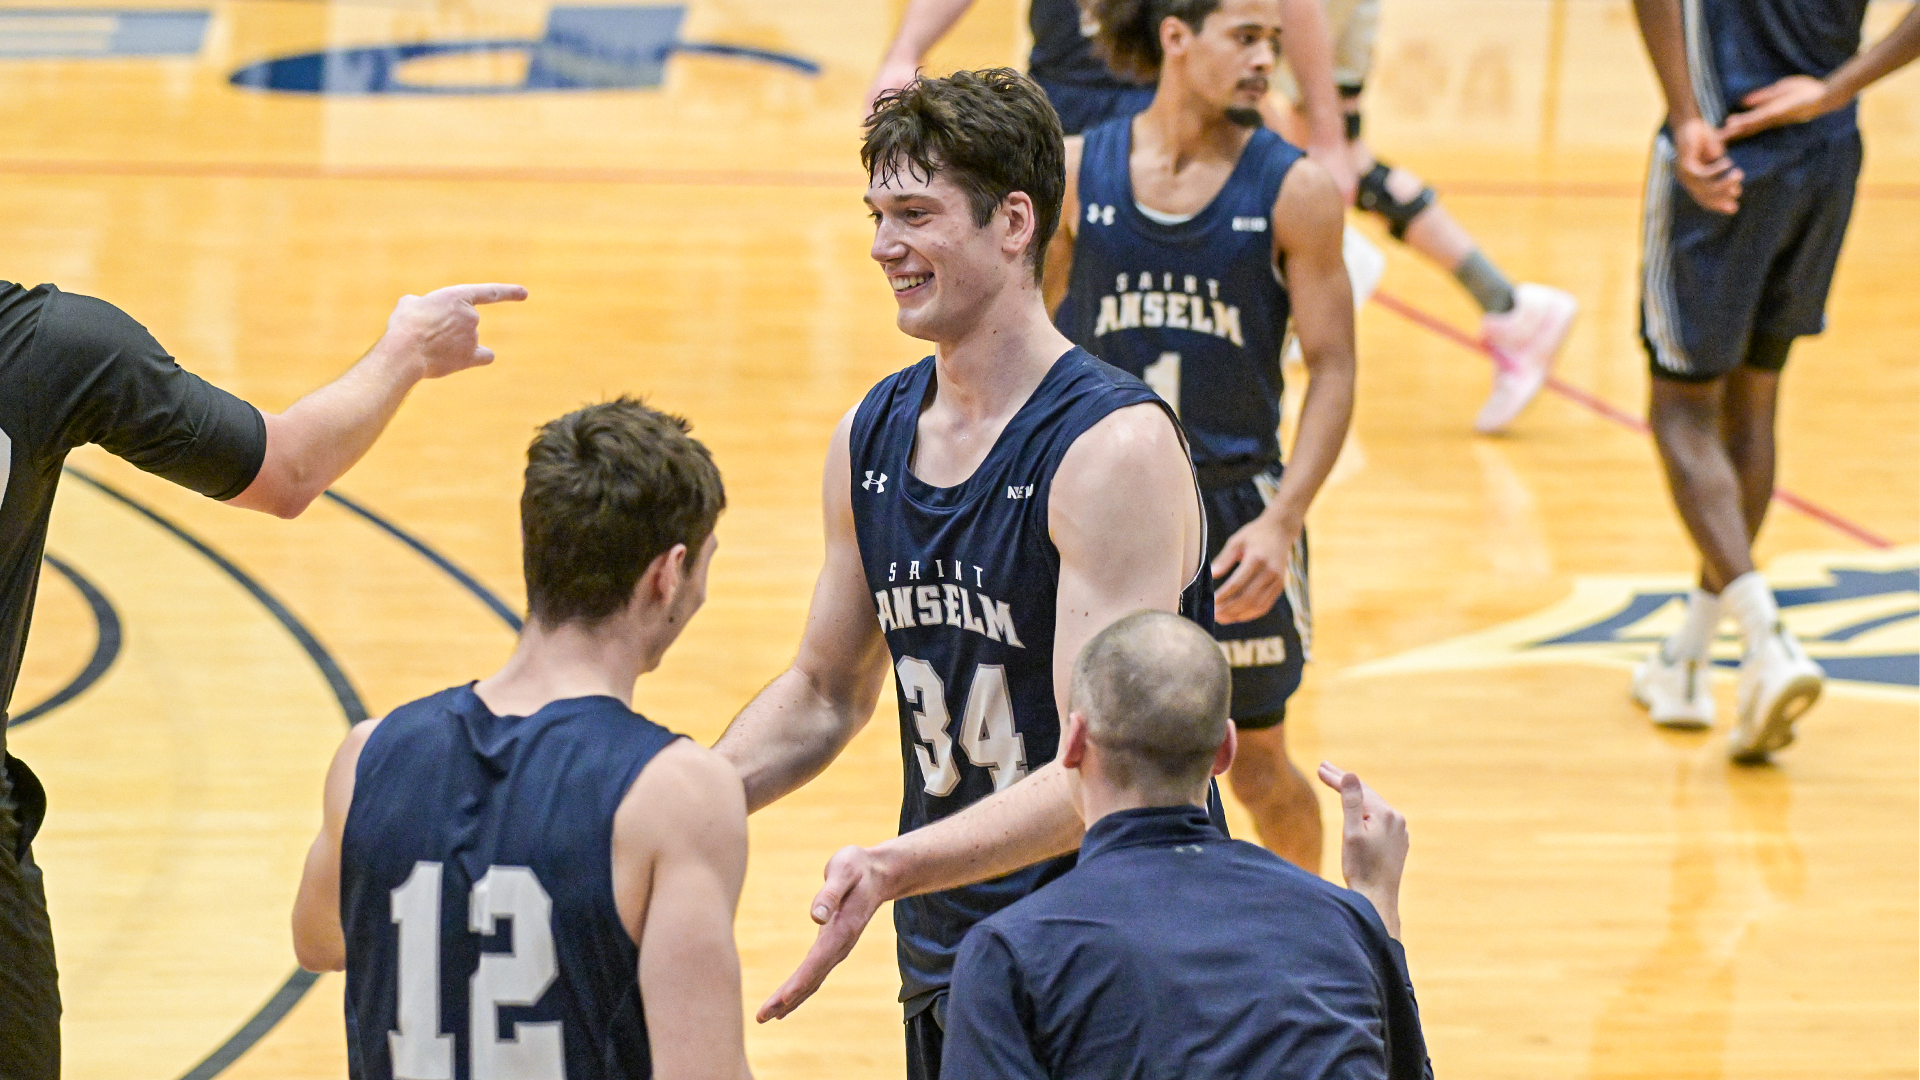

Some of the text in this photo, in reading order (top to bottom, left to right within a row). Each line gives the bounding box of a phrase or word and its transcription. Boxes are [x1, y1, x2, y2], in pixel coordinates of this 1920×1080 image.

[1115, 271, 1220, 300] SAINT
[1094, 292, 1246, 347] ANSELM
[1143, 351, 1182, 421] 1
[888, 559, 984, 588] SAINT
[875, 583, 1027, 650] ANSELM
[896, 655, 1029, 798] 34
[387, 860, 568, 1080] 12
